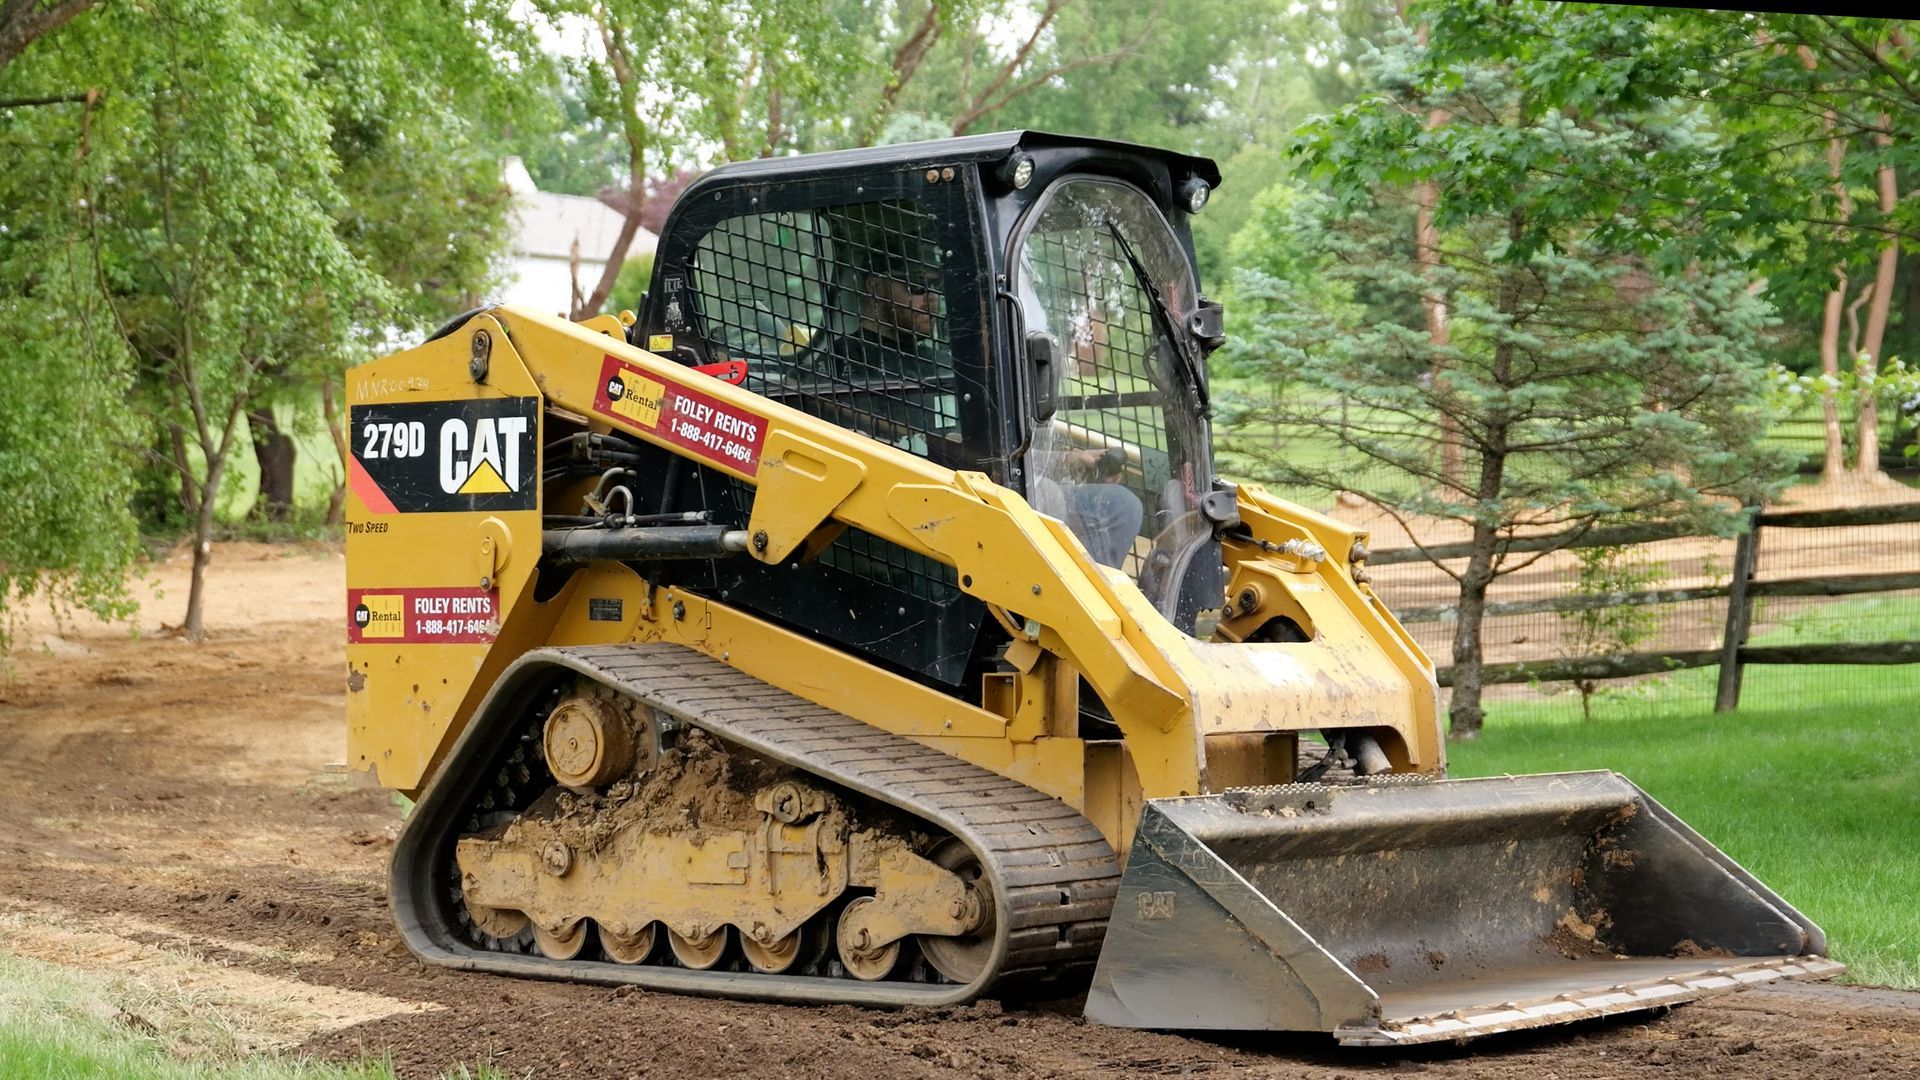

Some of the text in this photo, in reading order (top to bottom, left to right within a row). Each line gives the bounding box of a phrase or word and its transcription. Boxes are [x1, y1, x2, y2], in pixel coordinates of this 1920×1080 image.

[608, 381, 624, 396] CAT
[624, 388, 658, 411] Rental
[674, 395, 757, 442] FOLEY RENTS
[363, 421, 426, 459] 279D
[671, 418, 752, 463] 1-888-417-6464
[440, 417, 527, 494] CAT
[356, 610, 369, 622] CAT
[371, 611, 401, 622] Rental
[415, 597, 491, 614] FOLEY RENTS
[1138, 891, 1177, 920] CAT
